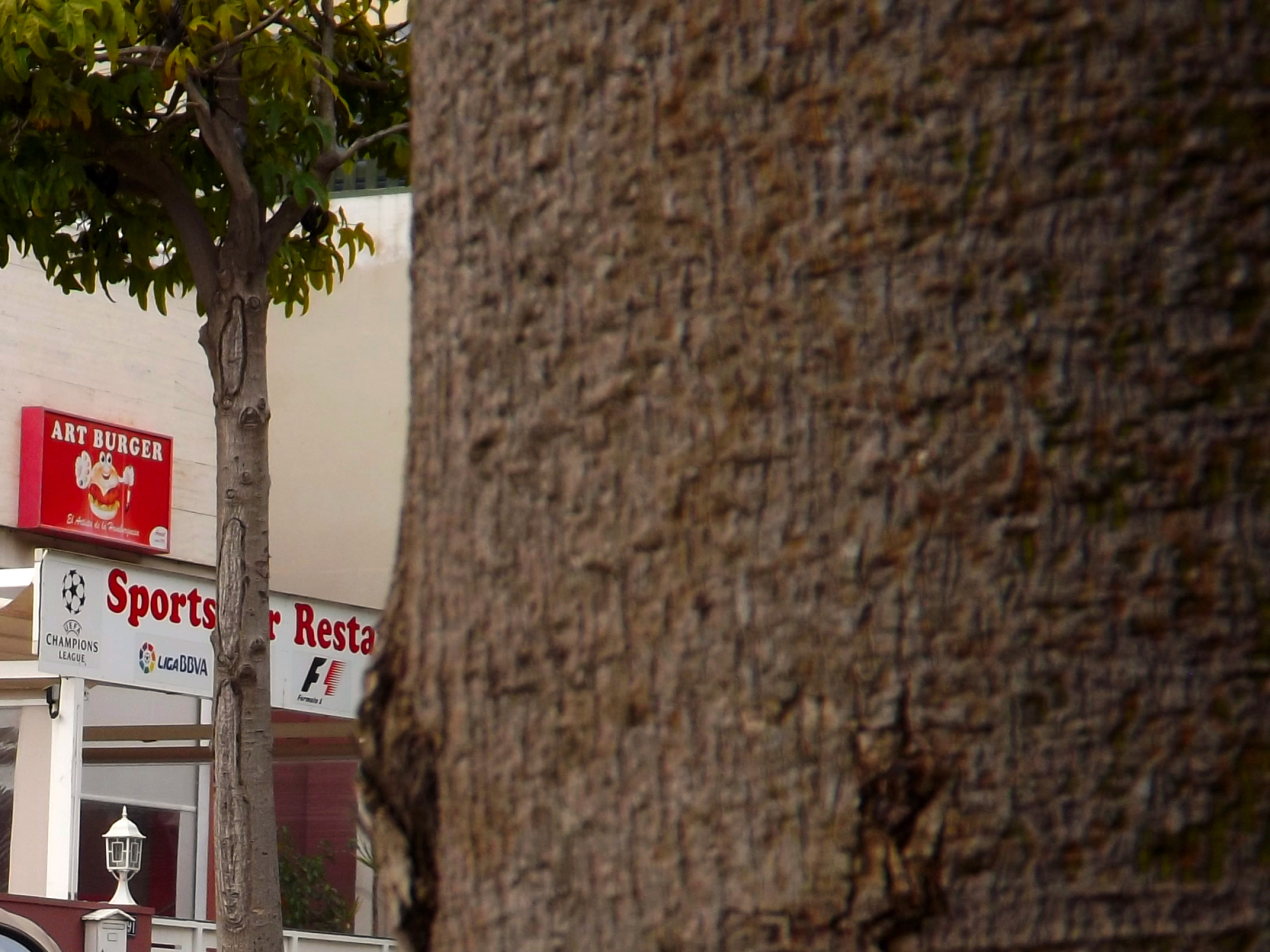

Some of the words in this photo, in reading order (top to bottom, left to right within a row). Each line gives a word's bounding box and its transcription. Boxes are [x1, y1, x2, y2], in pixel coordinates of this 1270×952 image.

[50, 420, 88, 445] ART
[92, 428, 163, 462] BURGER
[106, 568, 217, 630] Sports
[46, 633, 99, 653] CHAMPIONS
[58, 650, 85, 663] LEAGUE
